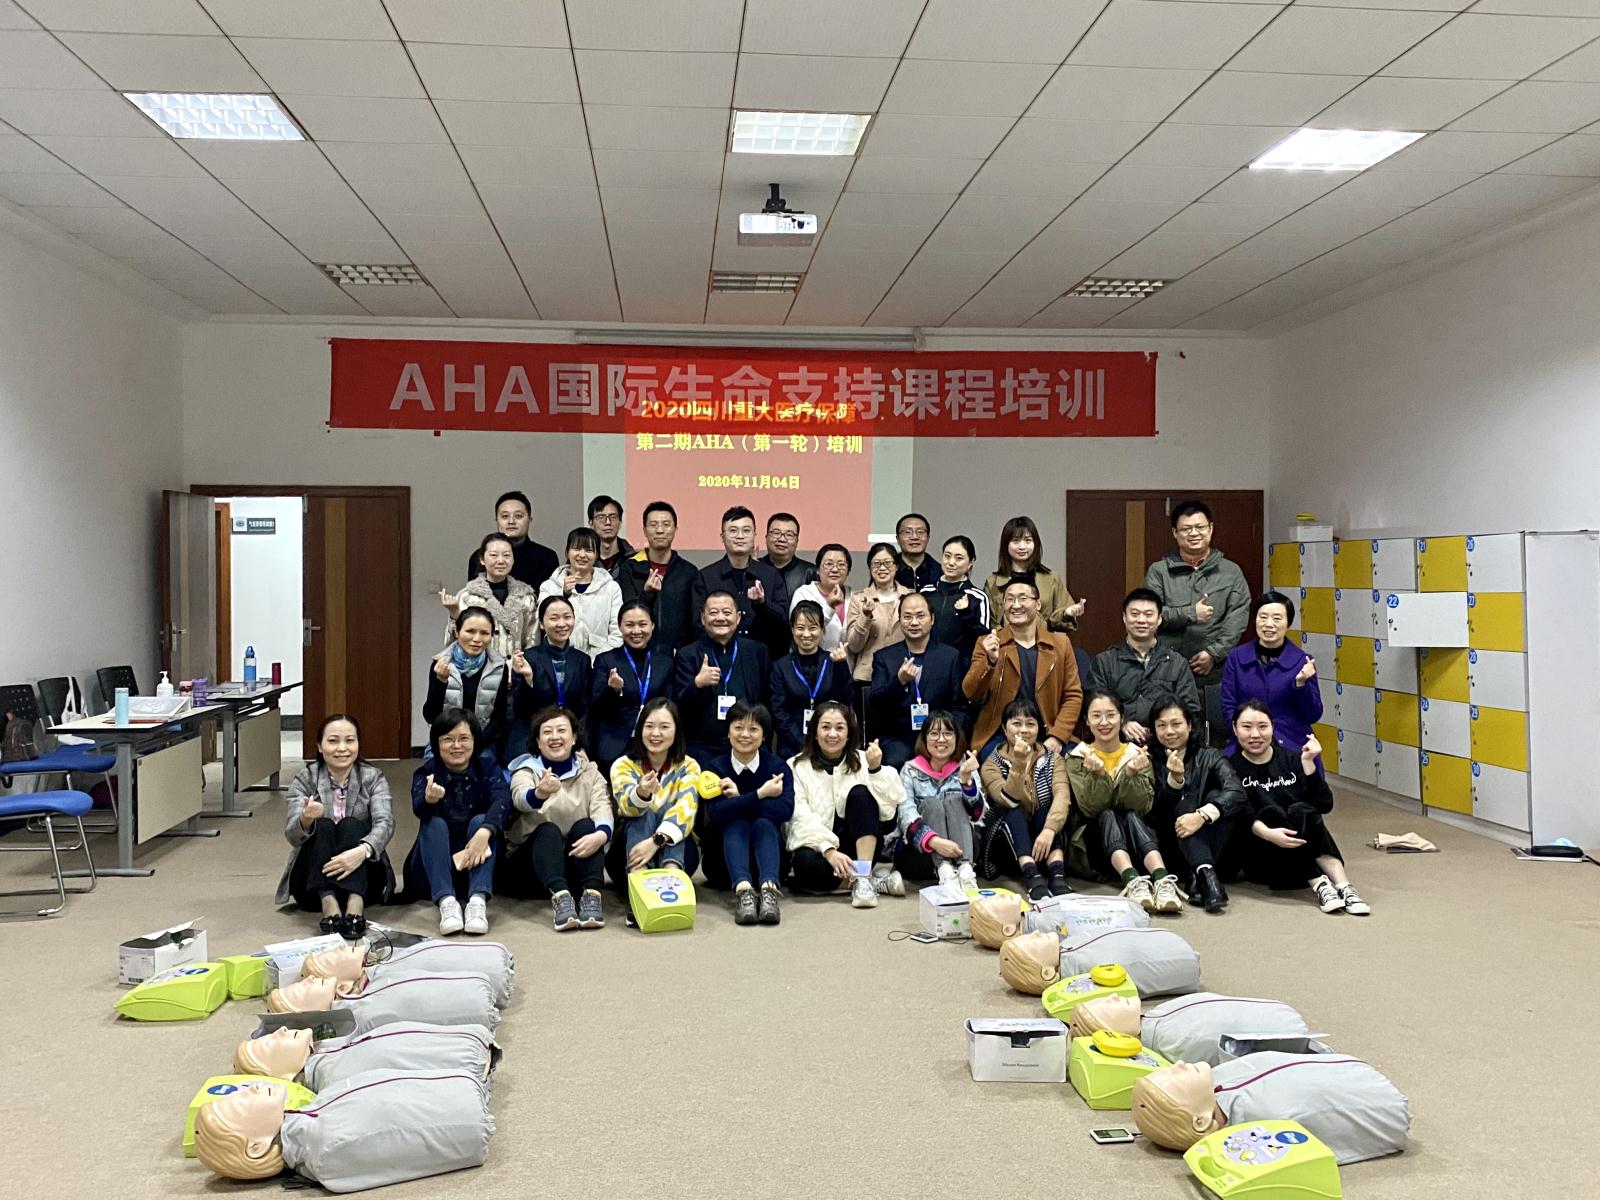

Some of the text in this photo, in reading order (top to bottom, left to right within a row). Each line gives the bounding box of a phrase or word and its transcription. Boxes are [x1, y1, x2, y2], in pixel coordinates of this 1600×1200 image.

[389, 363, 1105, 420] AHA国际生命支持课程培训
[698, 474, 800, 489] 2020年11月04日
[1388, 596, 1398, 606] 22
